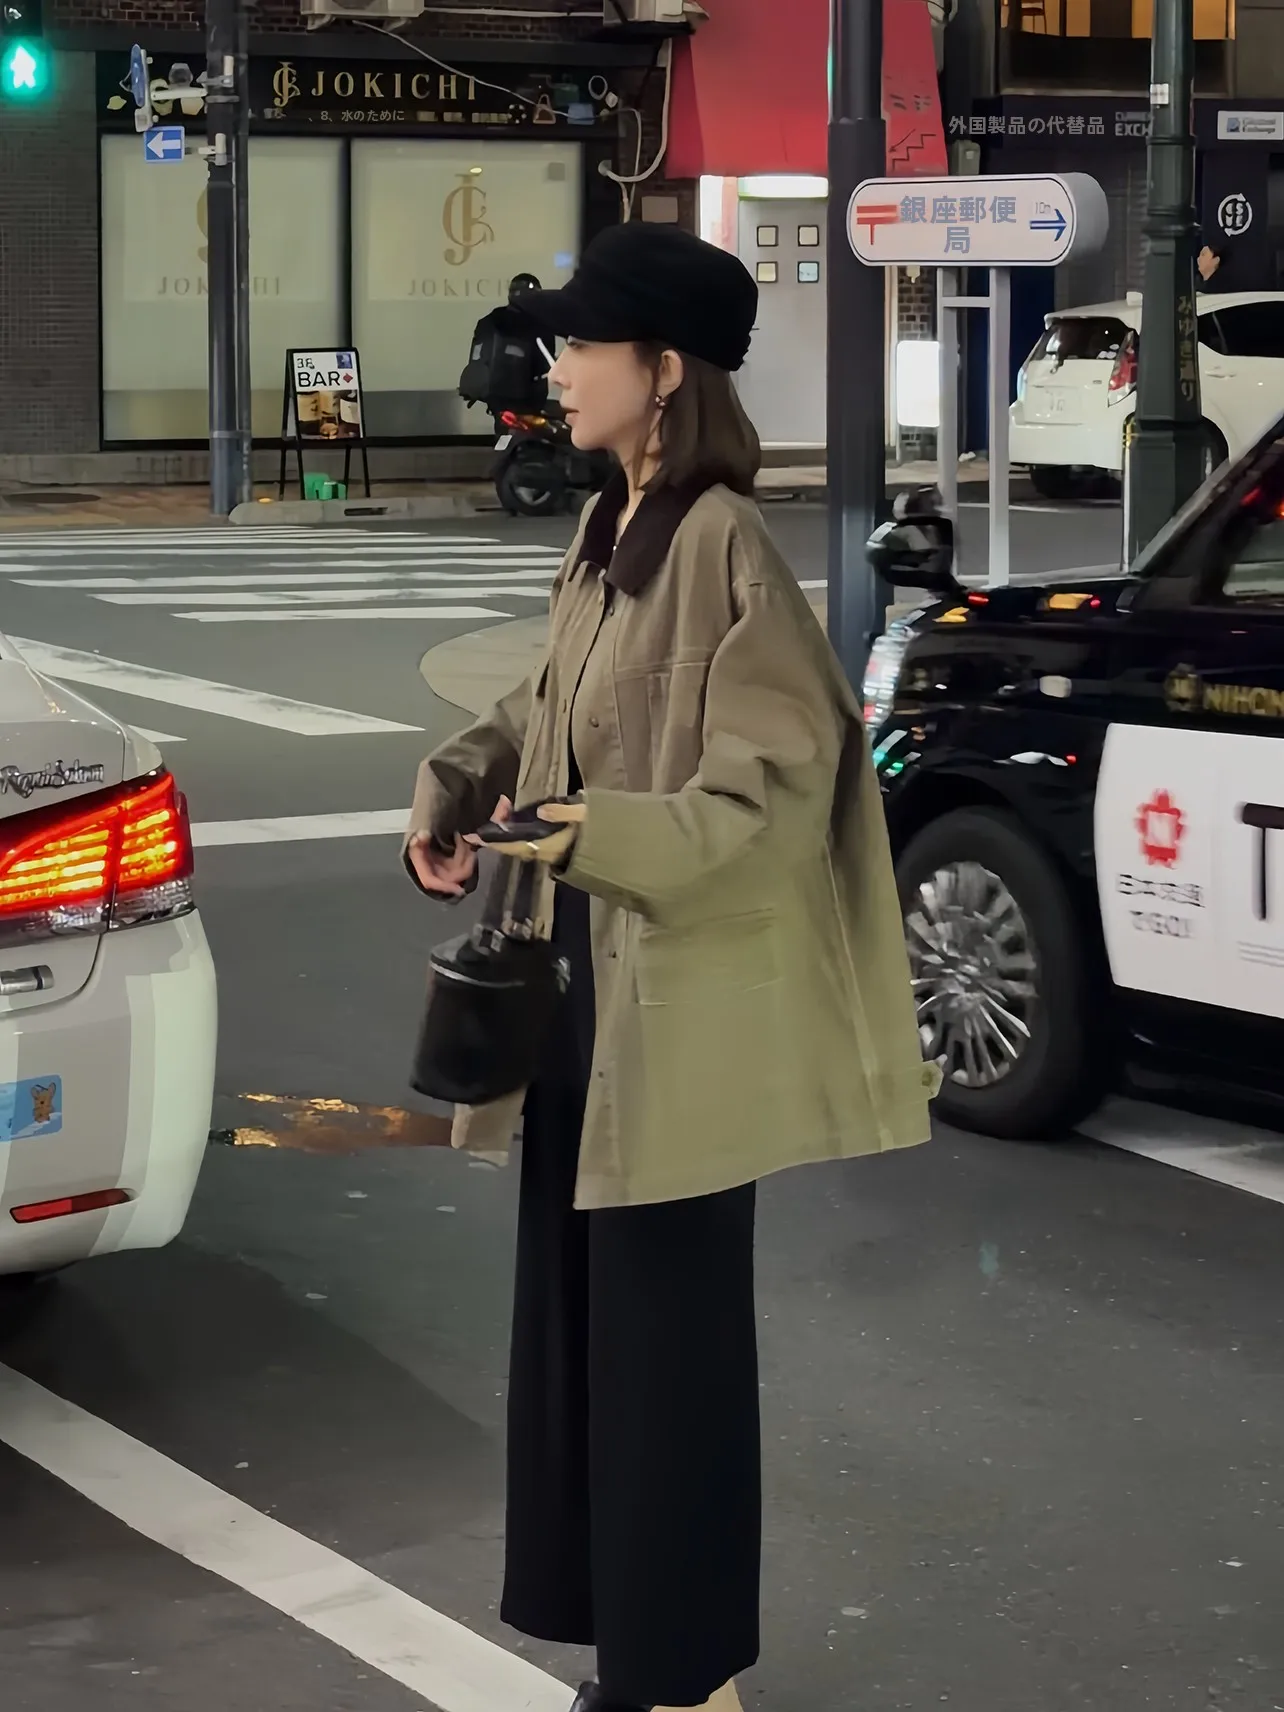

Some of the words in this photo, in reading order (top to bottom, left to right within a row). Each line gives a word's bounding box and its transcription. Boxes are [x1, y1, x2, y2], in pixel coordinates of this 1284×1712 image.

[311, 71, 477, 101] JOKICHI
[949, 115, 1105, 135] 外国製品の代替品
[899, 195, 1017, 224] 銀座郵便
[943, 226, 971, 253] 局
[297, 371, 341, 387] BAR
